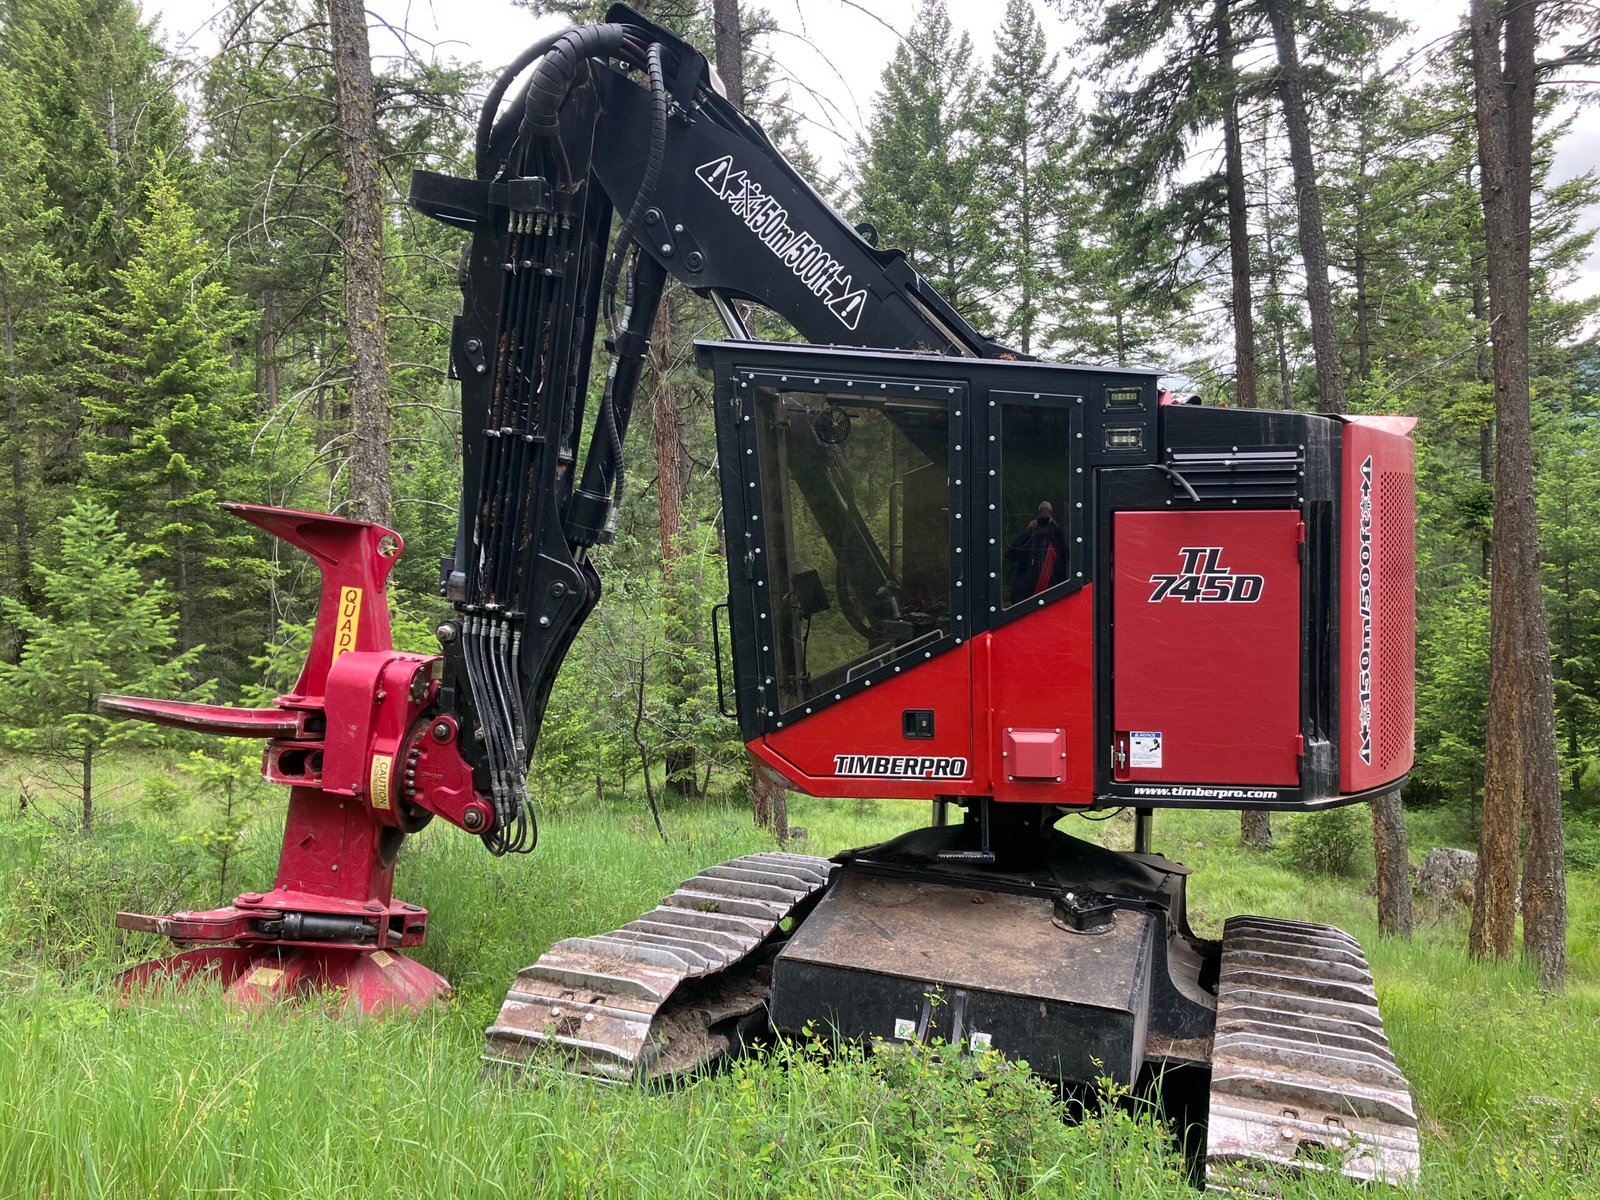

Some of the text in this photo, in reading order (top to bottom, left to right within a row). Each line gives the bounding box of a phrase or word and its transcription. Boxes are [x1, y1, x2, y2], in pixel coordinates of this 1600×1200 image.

[744, 195, 844, 296] 150m/500ft
[1178, 547, 1231, 575] TL
[1148, 574, 1265, 603] 745D
[1360, 515, 1371, 707] 150m/500ft
[834, 755, 967, 777] TIMBERPRO
[379, 762, 388, 805] CAUTION
[1134, 787, 1278, 799] www.timberpro.com
